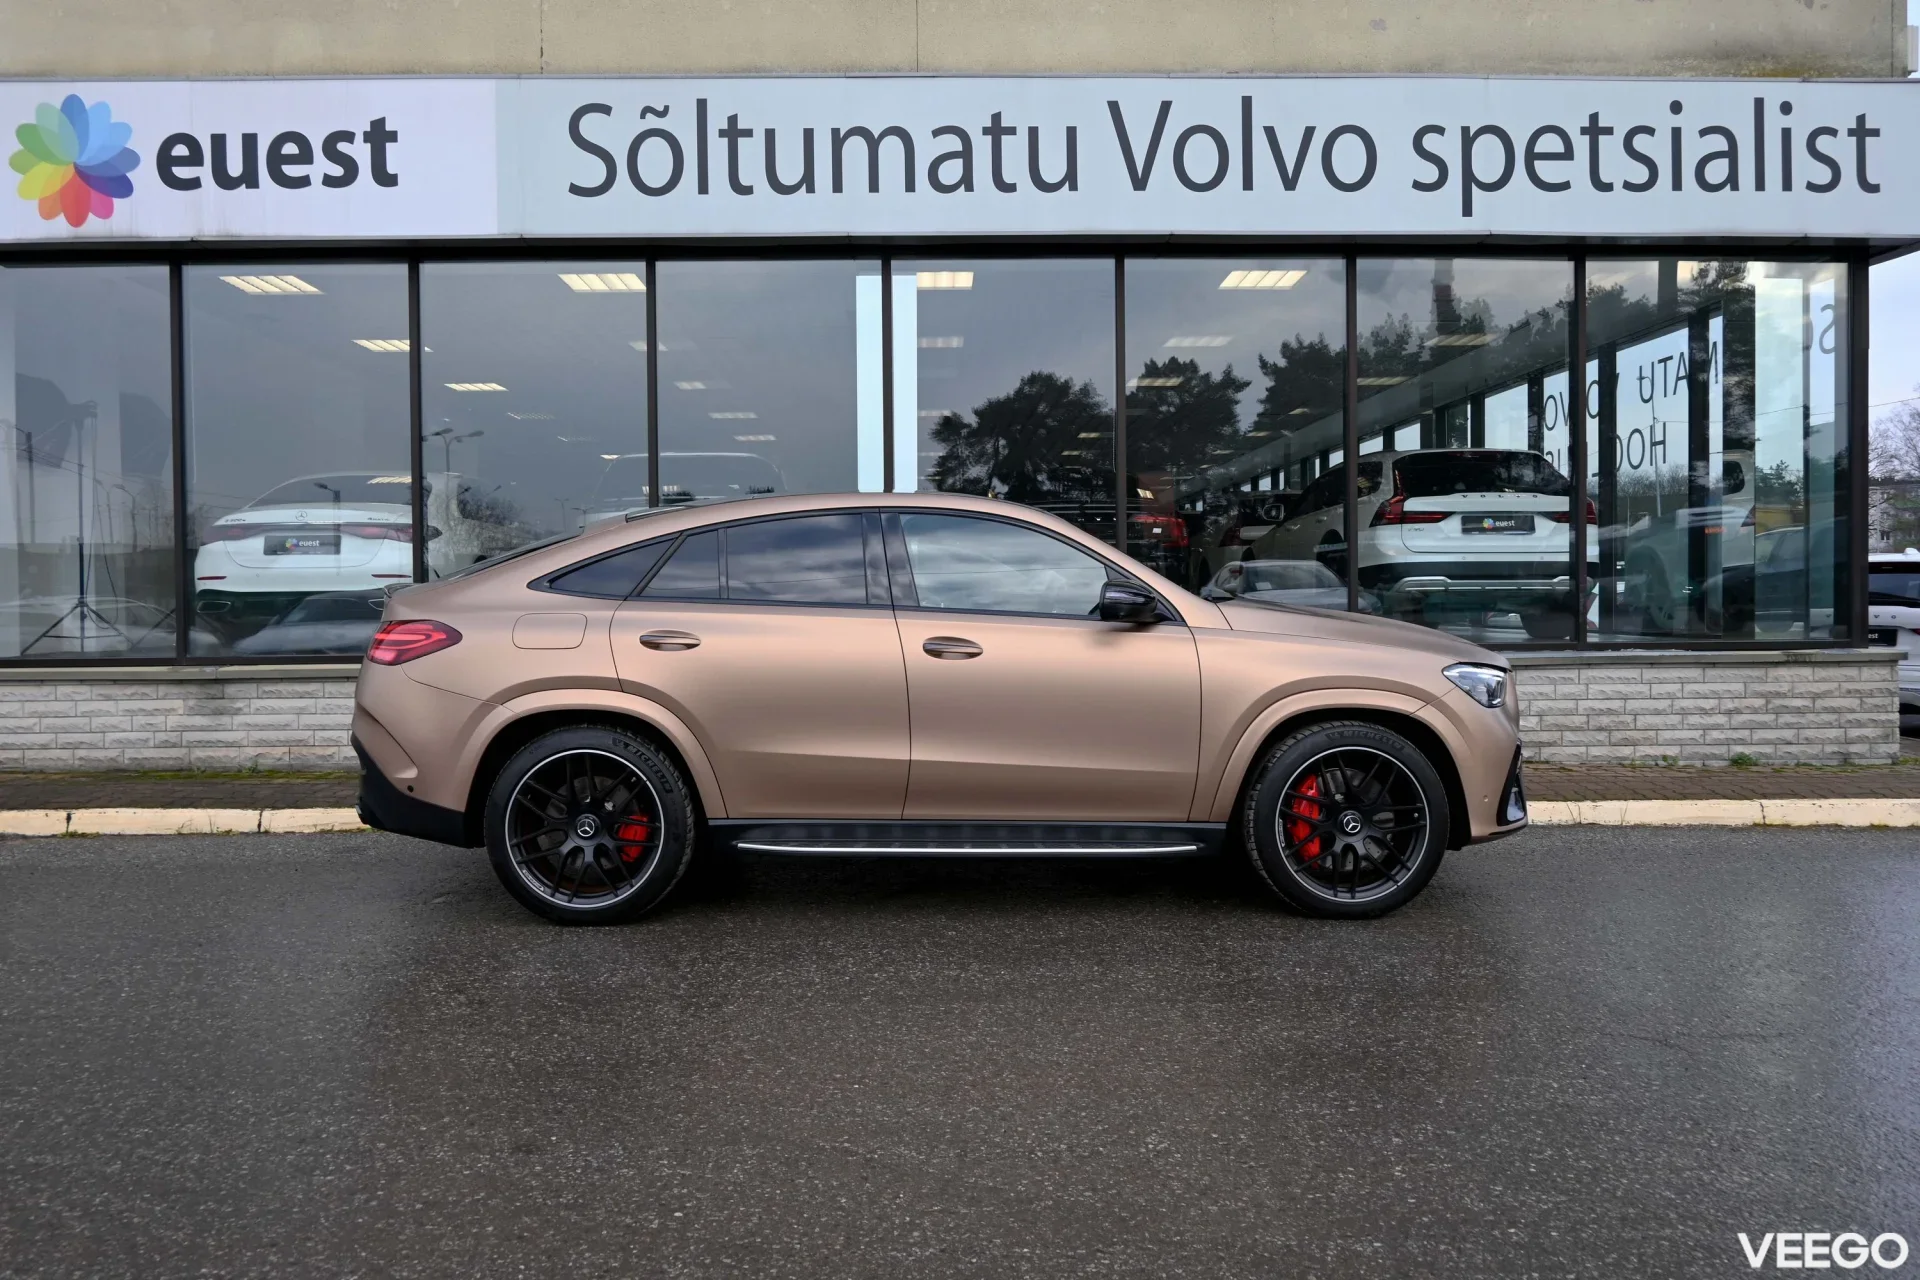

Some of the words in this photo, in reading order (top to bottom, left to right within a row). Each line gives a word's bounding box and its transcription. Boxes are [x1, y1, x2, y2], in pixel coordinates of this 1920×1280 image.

[156, 117, 398, 191] euest
[569, 99, 1078, 197] Sõltumatu
[1107, 96, 1377, 192] Volvo
[1412, 97, 1880, 217] spetsialist
[626, 744, 674, 793] MICHELIN
